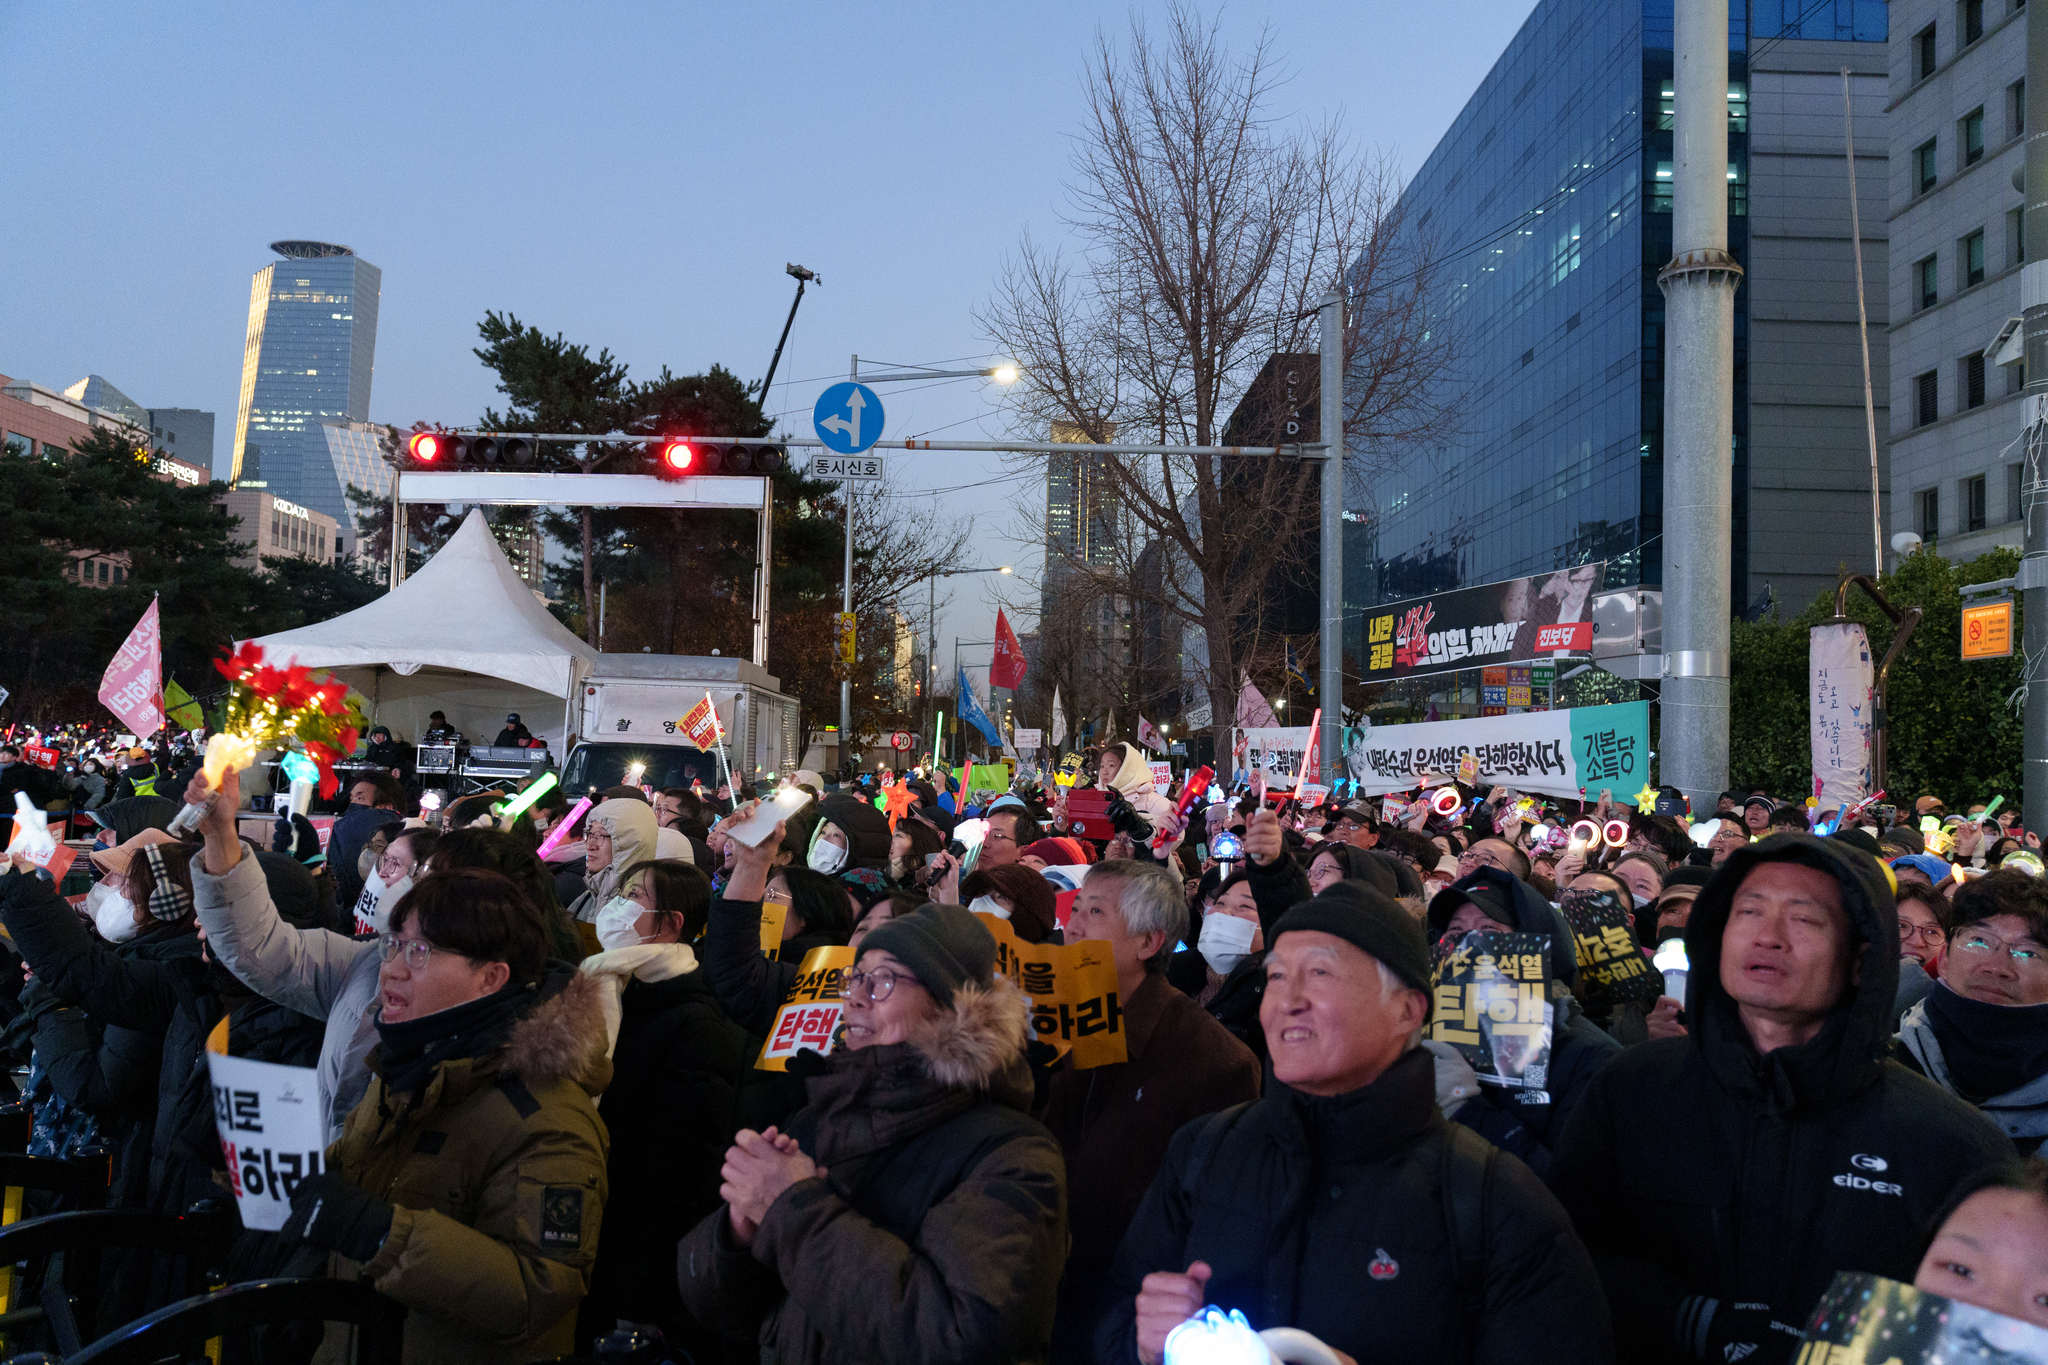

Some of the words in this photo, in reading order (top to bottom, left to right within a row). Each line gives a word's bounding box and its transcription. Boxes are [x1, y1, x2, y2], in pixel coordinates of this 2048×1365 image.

[815, 459, 879, 476] 동시신호
[1368, 614, 1394, 643] 내란
[1539, 627, 1576, 647] 진보당
[1369, 643, 1394, 670] 공범
[1819, 668, 1827, 704] 지금도
[1830, 686, 1839, 709] 오고
[1583, 728, 1617, 757] 기본
[1830, 719, 1842, 768] 있습니다
[28, 749, 53, 764] 탄핵
[1366, 748, 1412, 778] 내란수괴
[1474, 739, 1566, 776] 탄핵합시다
[1586, 757, 1619, 782] 소득
[1152, 774, 1170, 785] 하라
[1473, 953, 1543, 979] 윤석열
[1432, 983, 1545, 1046] 탄핵
